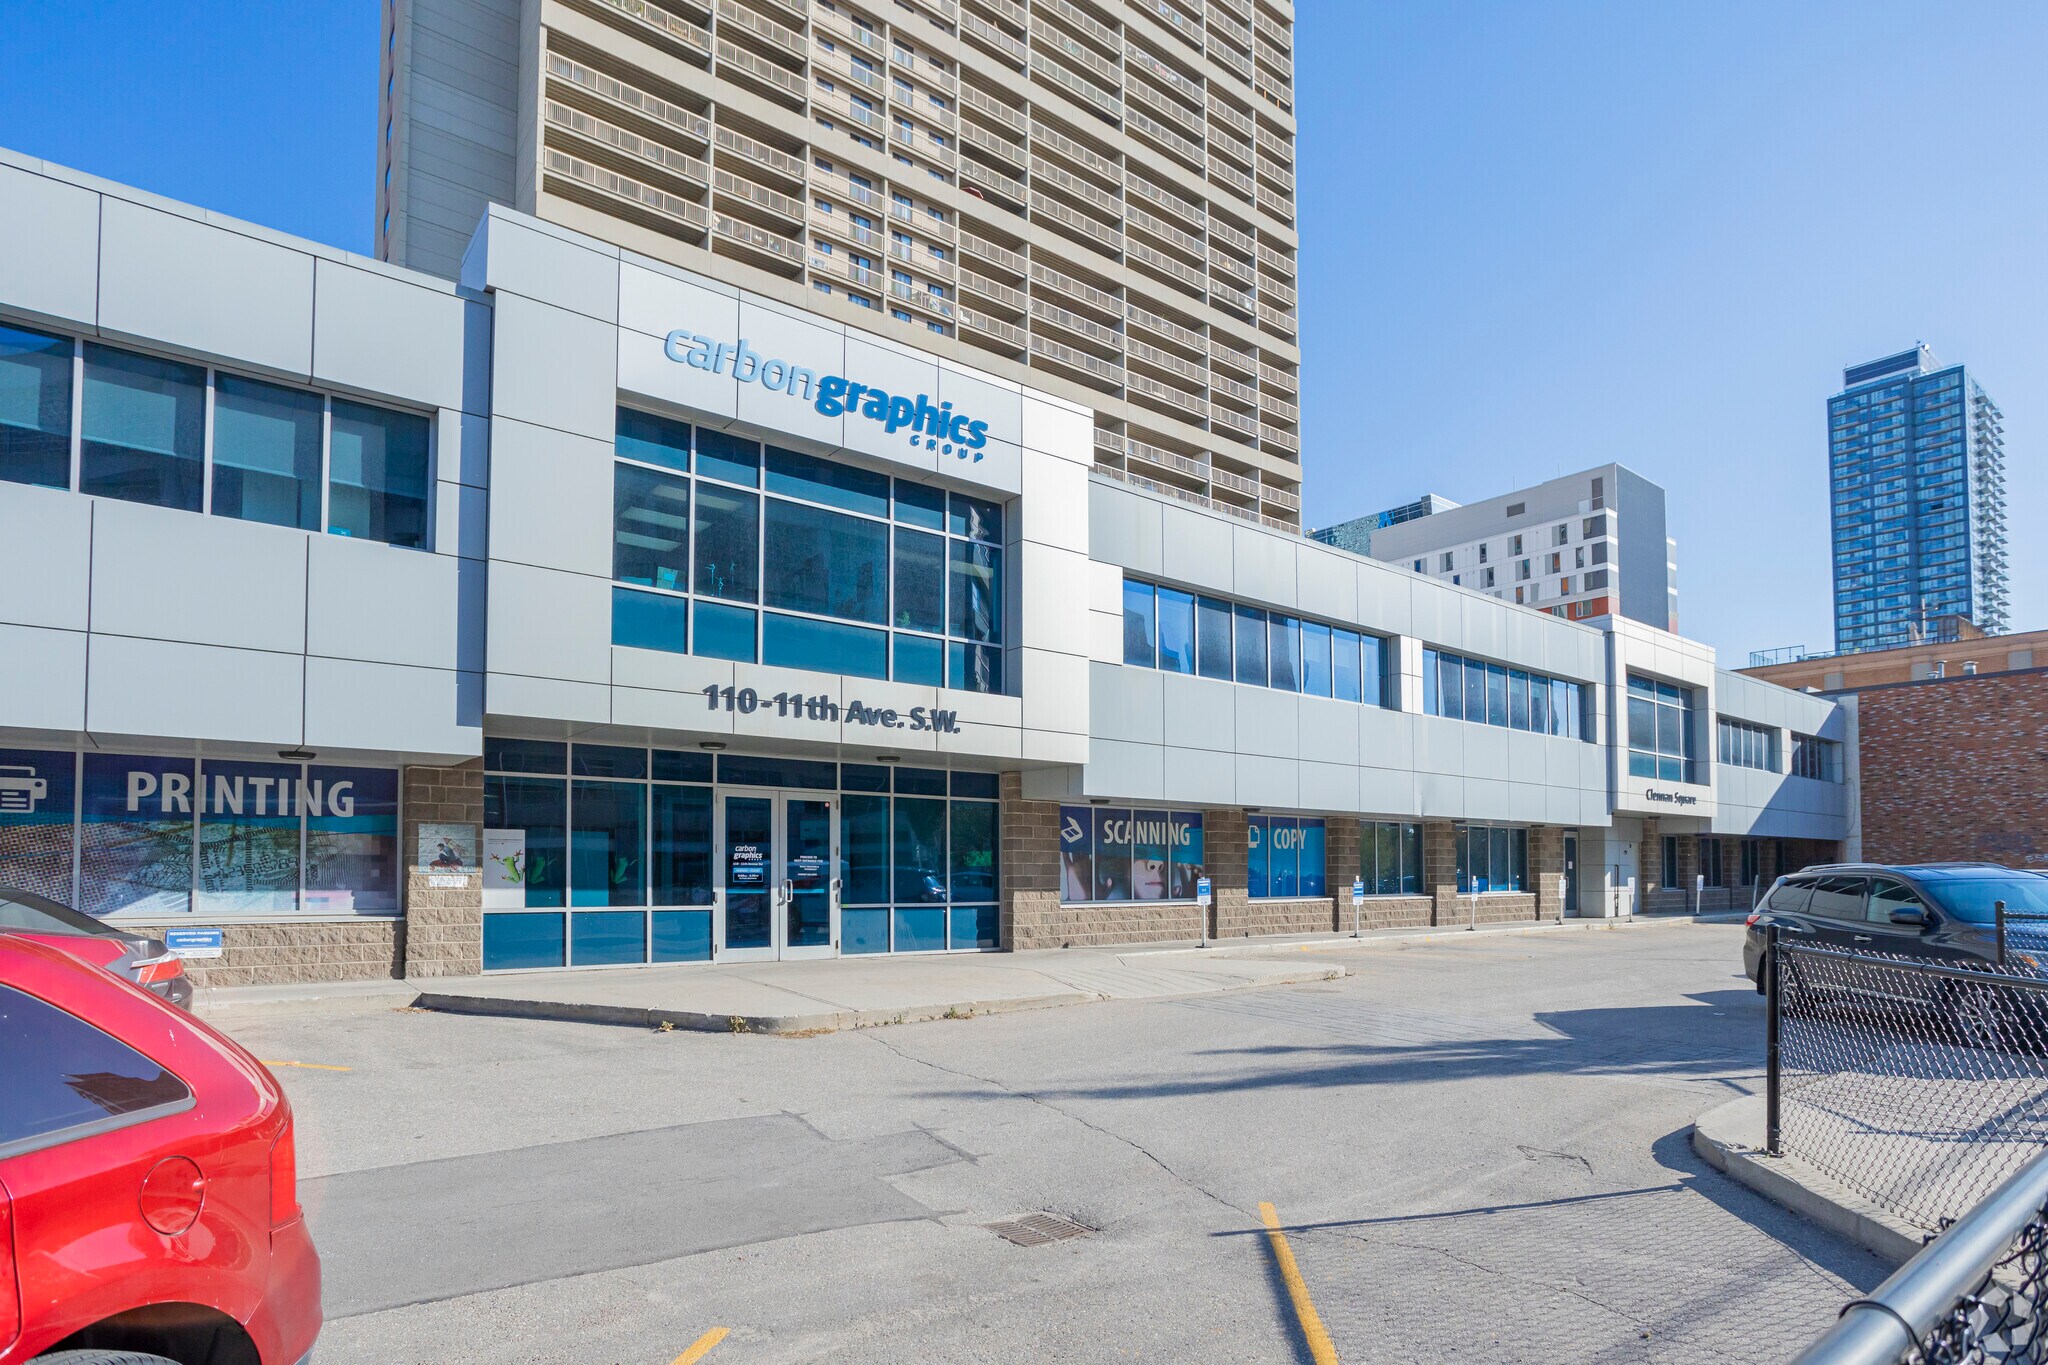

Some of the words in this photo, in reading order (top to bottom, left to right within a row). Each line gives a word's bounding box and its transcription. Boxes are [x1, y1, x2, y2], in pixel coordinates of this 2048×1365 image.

[909, 434, 985, 463] GROUP
[844, 700, 905, 728] Ave.
[909, 706, 961, 734] S.W.
[127, 771, 354, 818] PRINTING
[1674, 791, 1697, 806] Square
[1103, 819, 1191, 846] SCANNING
[1273, 828, 1307, 849] COPY
[733, 852, 763, 860] graphics
